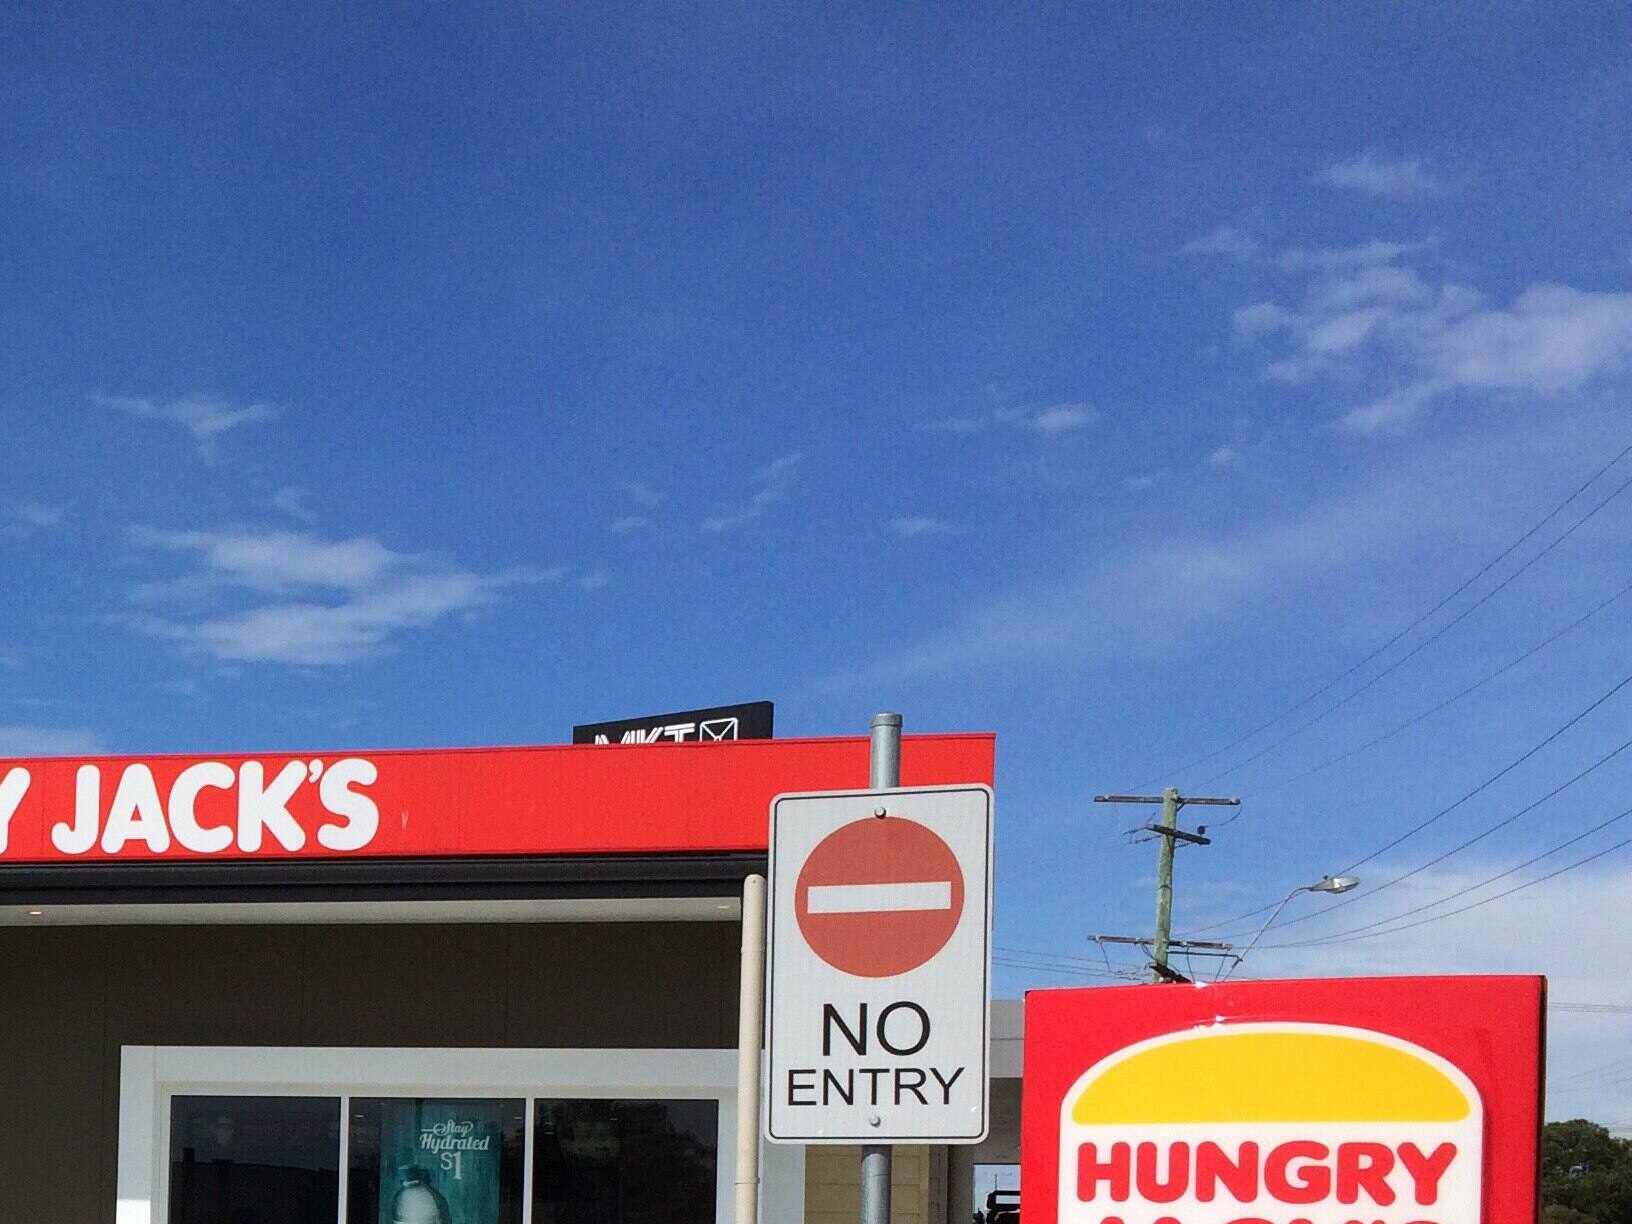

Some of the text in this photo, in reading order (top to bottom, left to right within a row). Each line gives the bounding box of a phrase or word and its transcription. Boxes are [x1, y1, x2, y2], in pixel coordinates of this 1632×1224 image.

[594, 722, 696, 744] KT
[52, 757, 379, 856] JACK'S
[822, 1001, 931, 1057] NO
[788, 1066, 965, 1106] ENTRY
[419, 1133, 491, 1154] Hydrated
[1077, 1140, 1457, 1206] HUNGRY
